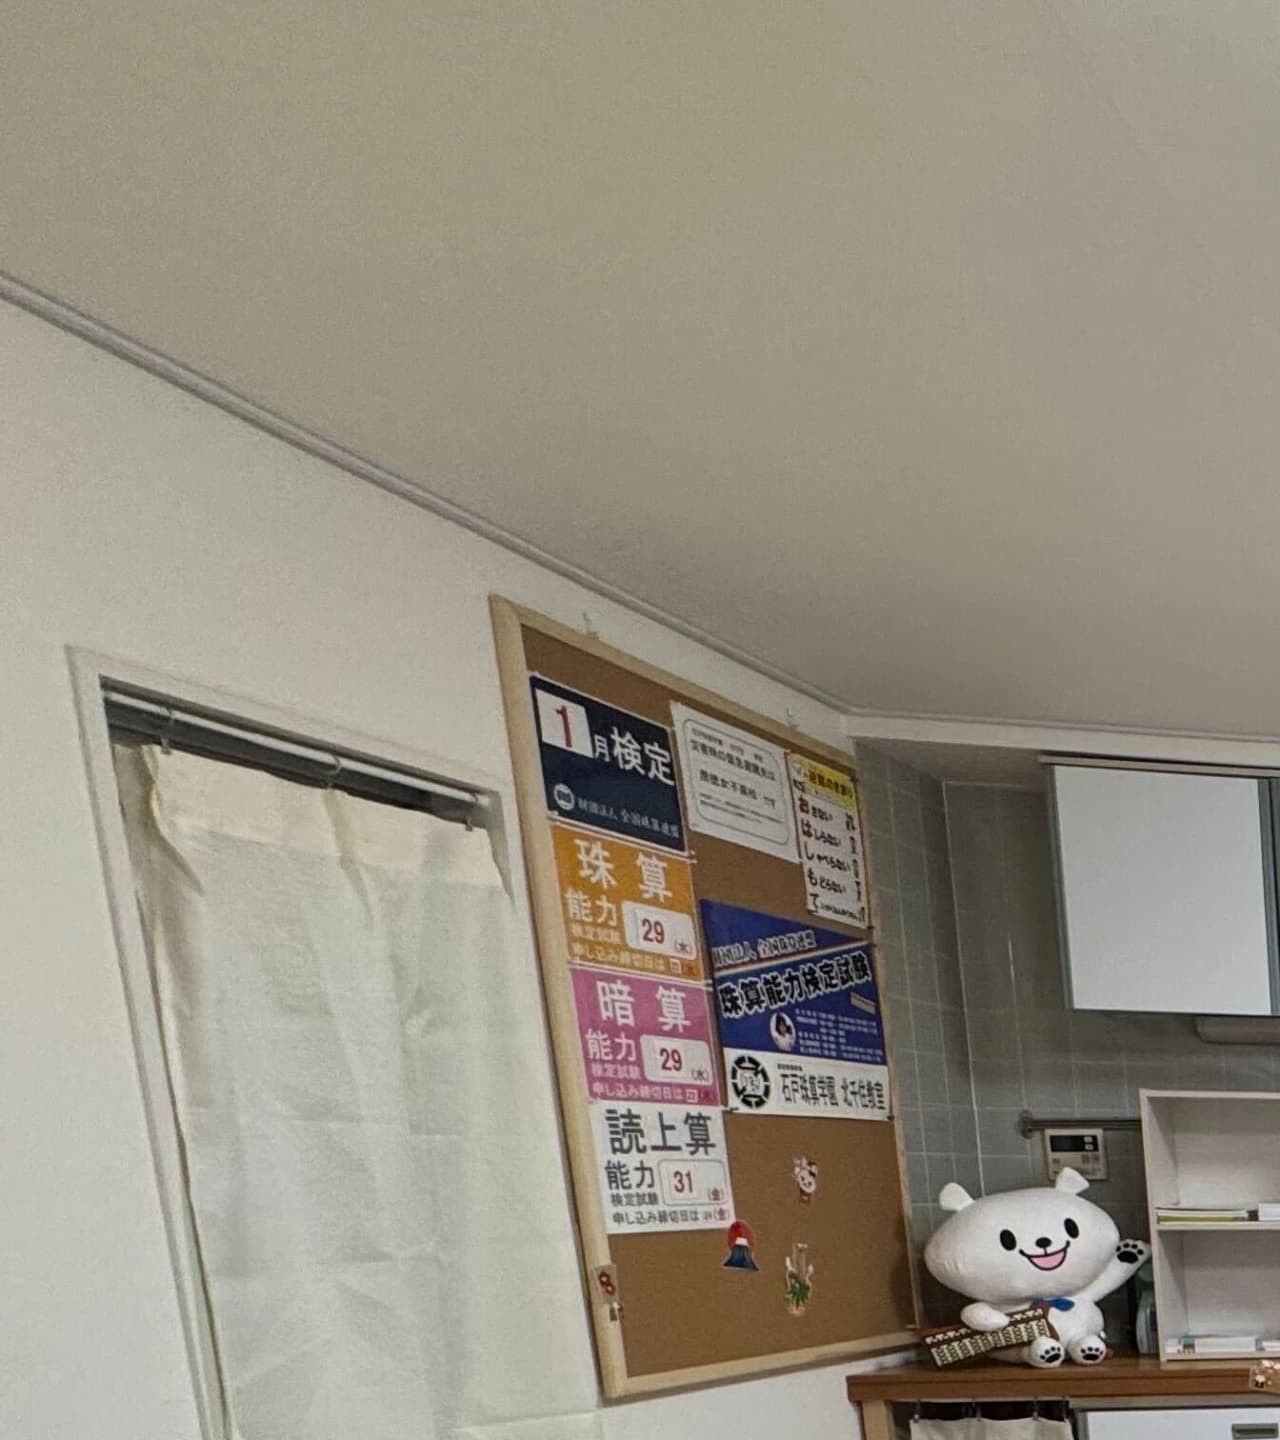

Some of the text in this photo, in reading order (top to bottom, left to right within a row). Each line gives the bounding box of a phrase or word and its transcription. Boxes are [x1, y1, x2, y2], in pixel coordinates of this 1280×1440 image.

[574, 839, 672, 902] 珠算
[564, 887, 617, 926] 能力
[642, 918, 665, 944] 29
[719, 951, 871, 1017] 珠算能力検定試験
[596, 979, 691, 1032] 暗算
[585, 1028, 637, 1061] 能力
[590, 1063, 641, 1079] 検定試験
[659, 1047, 682, 1071] 29
[592, 1081, 682, 1099] 申し込み締切日は
[605, 1108, 716, 1155] 読上算
[604, 1160, 656, 1190] 能力
[674, 1170, 693, 1193] 31
[610, 1192, 659, 1206] 検定試験
[612, 1209, 699, 1225] 申し込み締切日は
